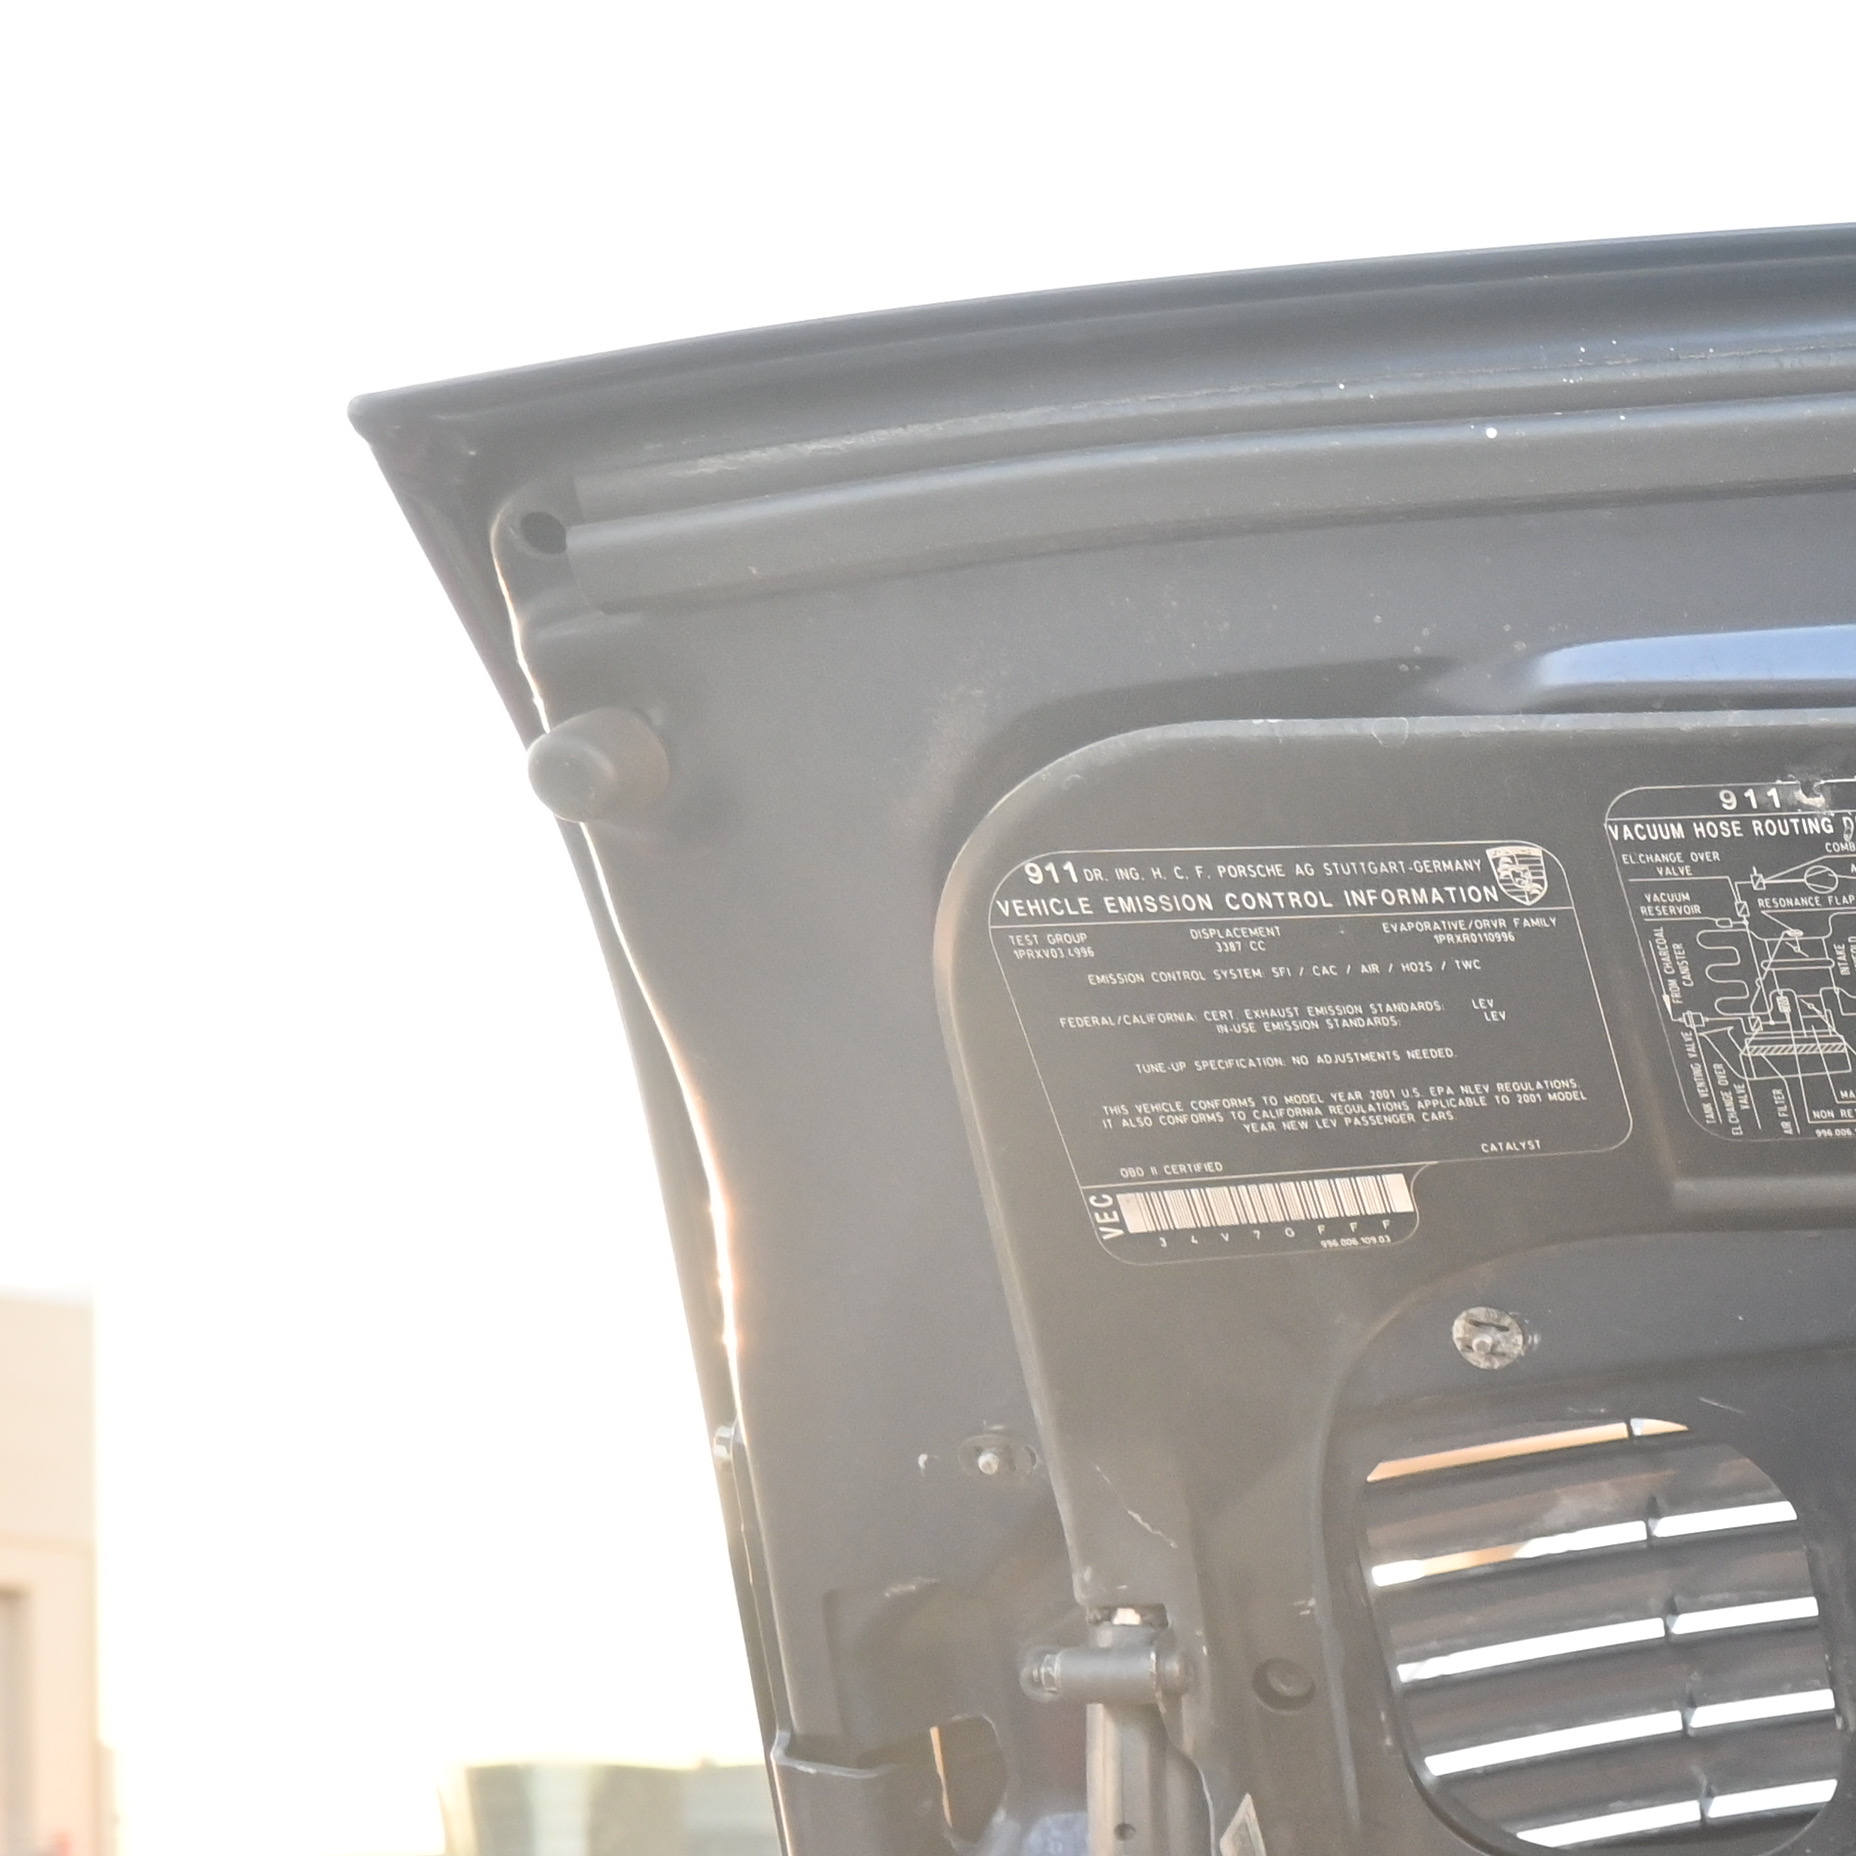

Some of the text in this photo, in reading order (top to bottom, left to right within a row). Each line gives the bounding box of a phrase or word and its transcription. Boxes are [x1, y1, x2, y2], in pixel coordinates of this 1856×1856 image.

[1719, 787, 1780, 810] 911
[1608, 822, 1685, 840] VACUUM
[1692, 820, 1743, 838] HOSE
[1752, 817, 1834, 835] ROUTING
[1690, 851, 1720, 862] OVER
[1024, 858, 1482, 884] 911 DR. ING. H. C. F. PORSCHE AG STUTTGART-GERMANY
[1656, 865, 1693, 876] VALVE
[996, 885, 1499, 917] VEHICLE EMISSION CONTROL INFORMATION
[1644, 892, 1690, 903] VACUUM
[1757, 895, 1821, 908] RESONANCE
[1827, 894, 1856, 905] FLAP
[1640, 904, 1701, 916] RESERVOIR
[1190, 925, 1281, 939] DISPLACEMENT
[1381, 916, 1556, 932] EVAPORATIVE/ORVR FAMILY
[1008, 932, 1087, 945] TEST GROUP
[1215, 940, 1266, 952] 3387 CC
[1653, 926, 1683, 1003] FROM CHARCOAL
[1672, 942, 1694, 986] CANISTER
[1833, 942, 1850, 975] INTAKE
[1087, 973, 1144, 984] EMISSION
[1150, 970, 1205, 982] CONTROL
[1271, 966, 1291, 977] SFI
[1312, 964, 1337, 976] CAC
[1360, 963, 1379, 974] AIR
[1454, 959, 1481, 970] TWC
[1203, 1010, 1238, 1021] CERT.
[1243, 1006, 1300, 1019] EXHAUST
[1307, 1004, 1362, 1016] EMISSION
[1471, 998, 1493, 1009] LEV
[1215, 1023, 1256, 1034] IN-USE
[1263, 1020, 1319, 1032] EMISSION
[1484, 1010, 1506, 1021] LEV
[1136, 1061, 1186, 1073] TUNE-UP
[1291, 1055, 1308, 1066] NO
[1316, 1050, 1399, 1064] ADJUSTMENTS
[1406, 1047, 1456, 1059] NEEDED.
[1103, 1104, 1127, 1115] THIS
[1135, 1101, 1183, 1113] VEHICLE
[1190, 1097, 1254, 1110] CONFORMS
[1262, 1096, 1277, 1107] TO
[1284, 1094, 1324, 1105] MODEL
[1330, 1091, 1362, 1102] YEAR
[1369, 1089, 1395, 1100] 2001
[1429, 1085, 1453, 1096] EPA
[1460, 1084, 1489, 1095] NLEV
[1103, 1119, 1113, 1129] IT
[1121, 1117, 1152, 1128] ALSO
[1159, 1112, 1223, 1125] CONFORMS
[1230, 1111, 1246, 1122] TO
[1252, 1106, 1322, 1119] CALIFORNIA
[1416, 1097, 1487, 1110] APPLICABLE
[1495, 1095, 1509, 1106] TO
[1516, 1093, 1542, 1104] 2001
[1548, 1091, 1587, 1102] MODEL
[1243, 1122, 1276, 1133] YEAR
[1282, 1120, 1308, 1131] NEW
[1315, 1118, 1337, 1129] LEV
[1344, 1113, 1415, 1126] PASSENGER
[1812, 1109, 1834, 1120] NON
[1481, 1139, 1542, 1153] CATALYST
[1163, 1161, 1223, 1175] CERTIFIED
[1088, 1192, 1124, 1240] VEC
